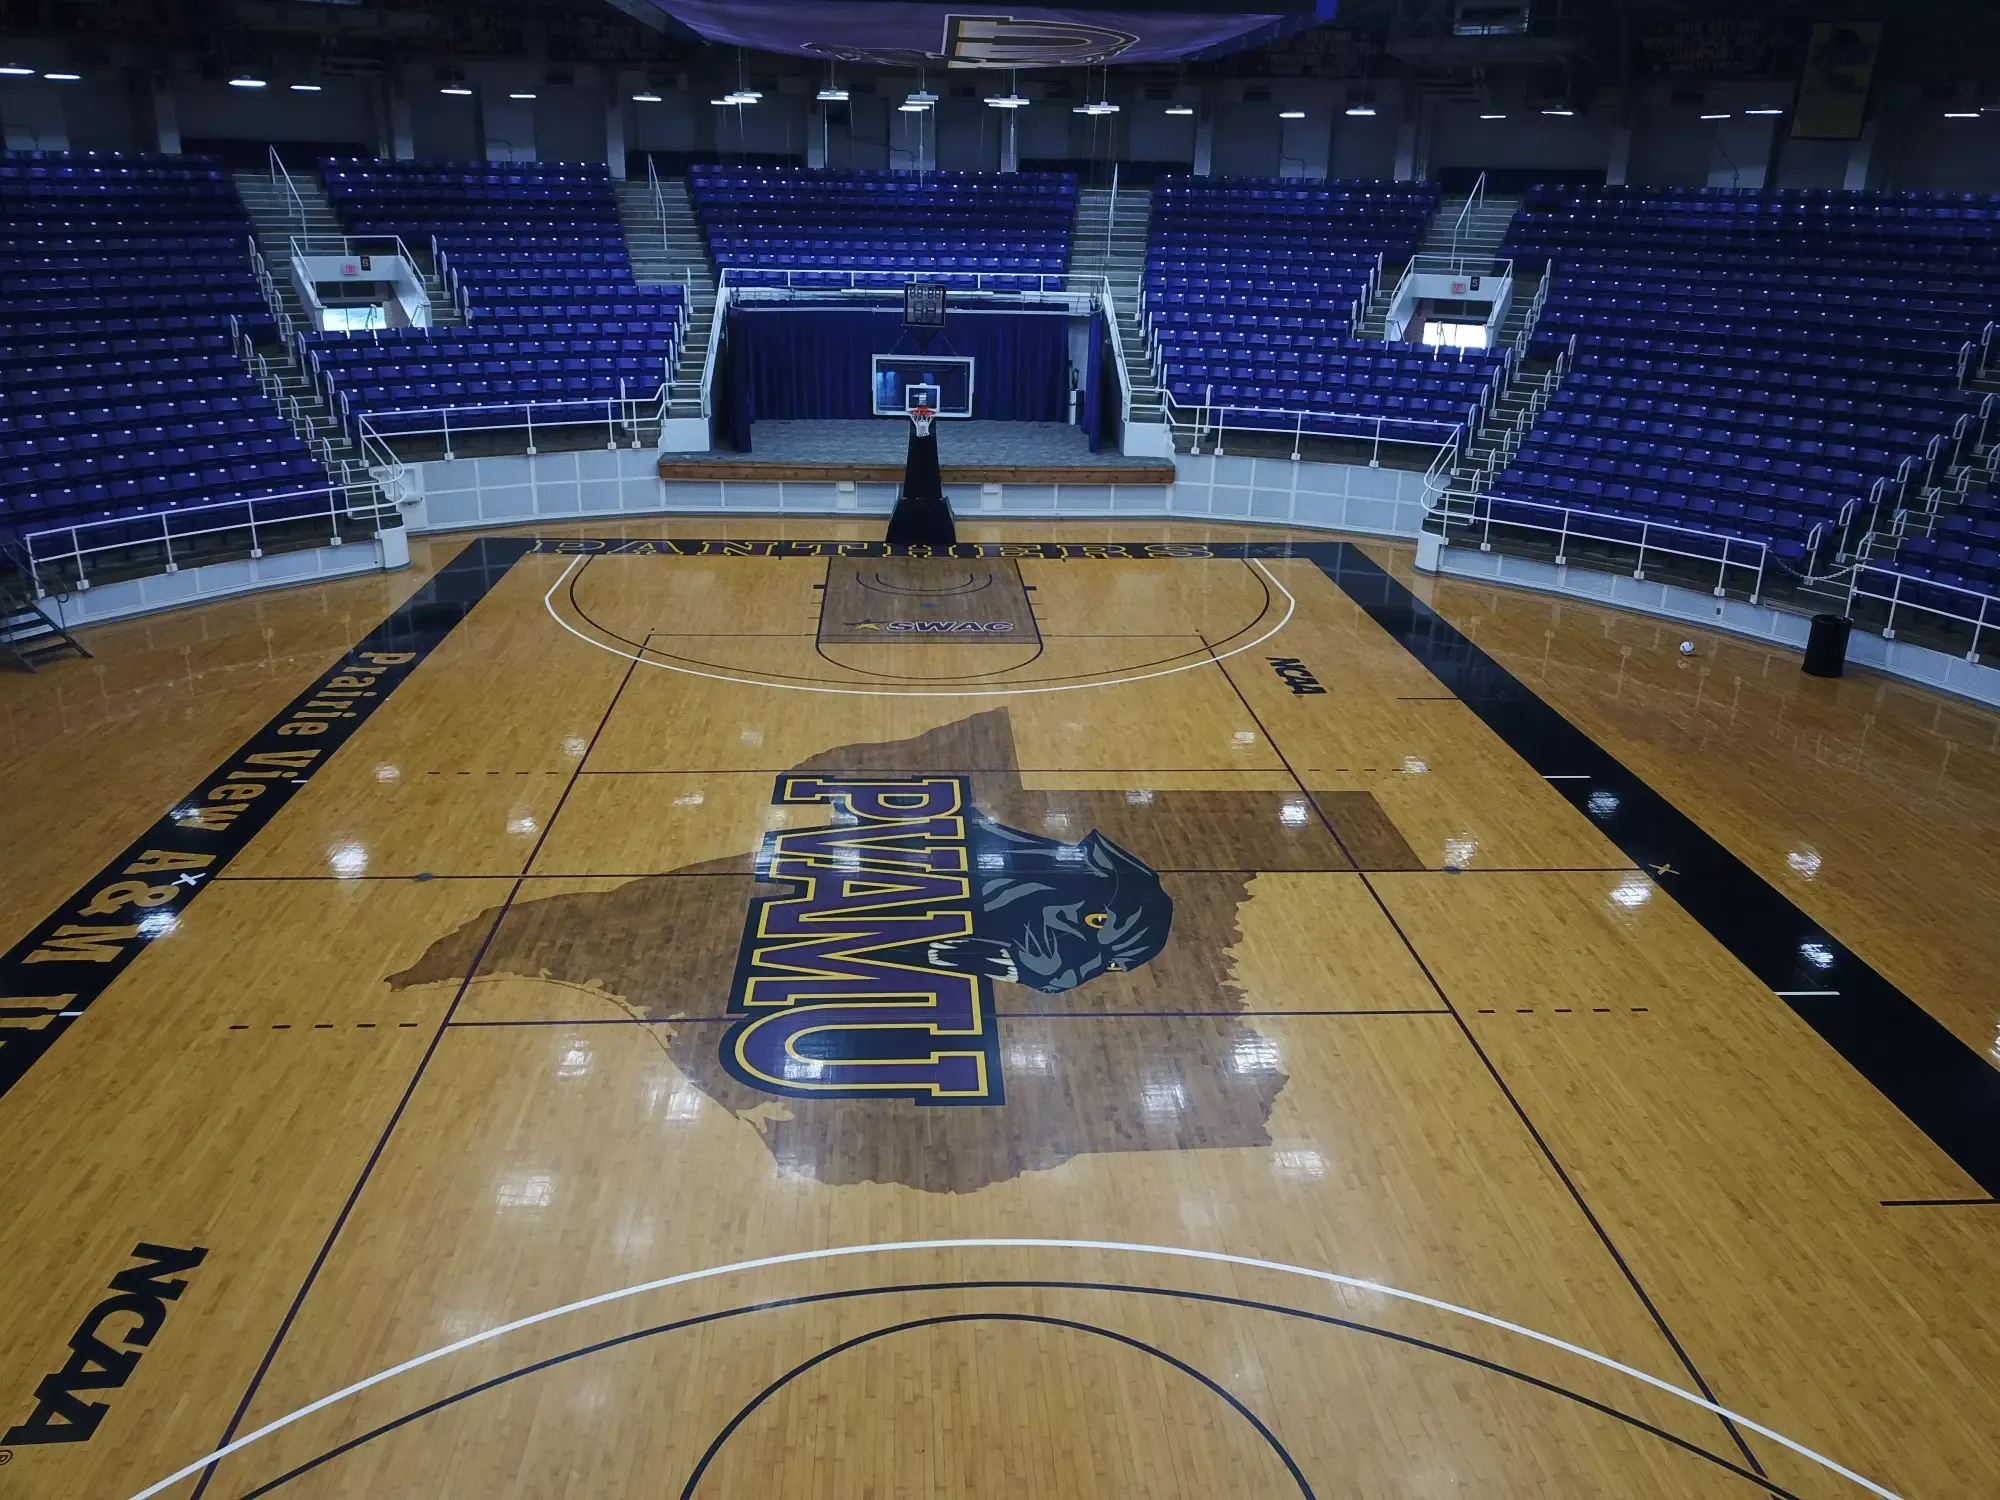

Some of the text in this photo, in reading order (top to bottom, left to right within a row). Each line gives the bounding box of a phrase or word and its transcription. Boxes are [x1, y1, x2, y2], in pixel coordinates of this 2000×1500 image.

[362, 258, 369, 267] 6
[525, 539, 1214, 559] PANTHERS
[885, 621, 1014, 633] SWAC
[276, 651, 417, 736] Prairie
[1264, 656, 1328, 695] NCAA
[175, 749, 322, 832] View
[20, 849, 218, 964] A&M
[728, 775, 996, 1101] PVAMU
[0, 1242, 210, 1446] NCAA
